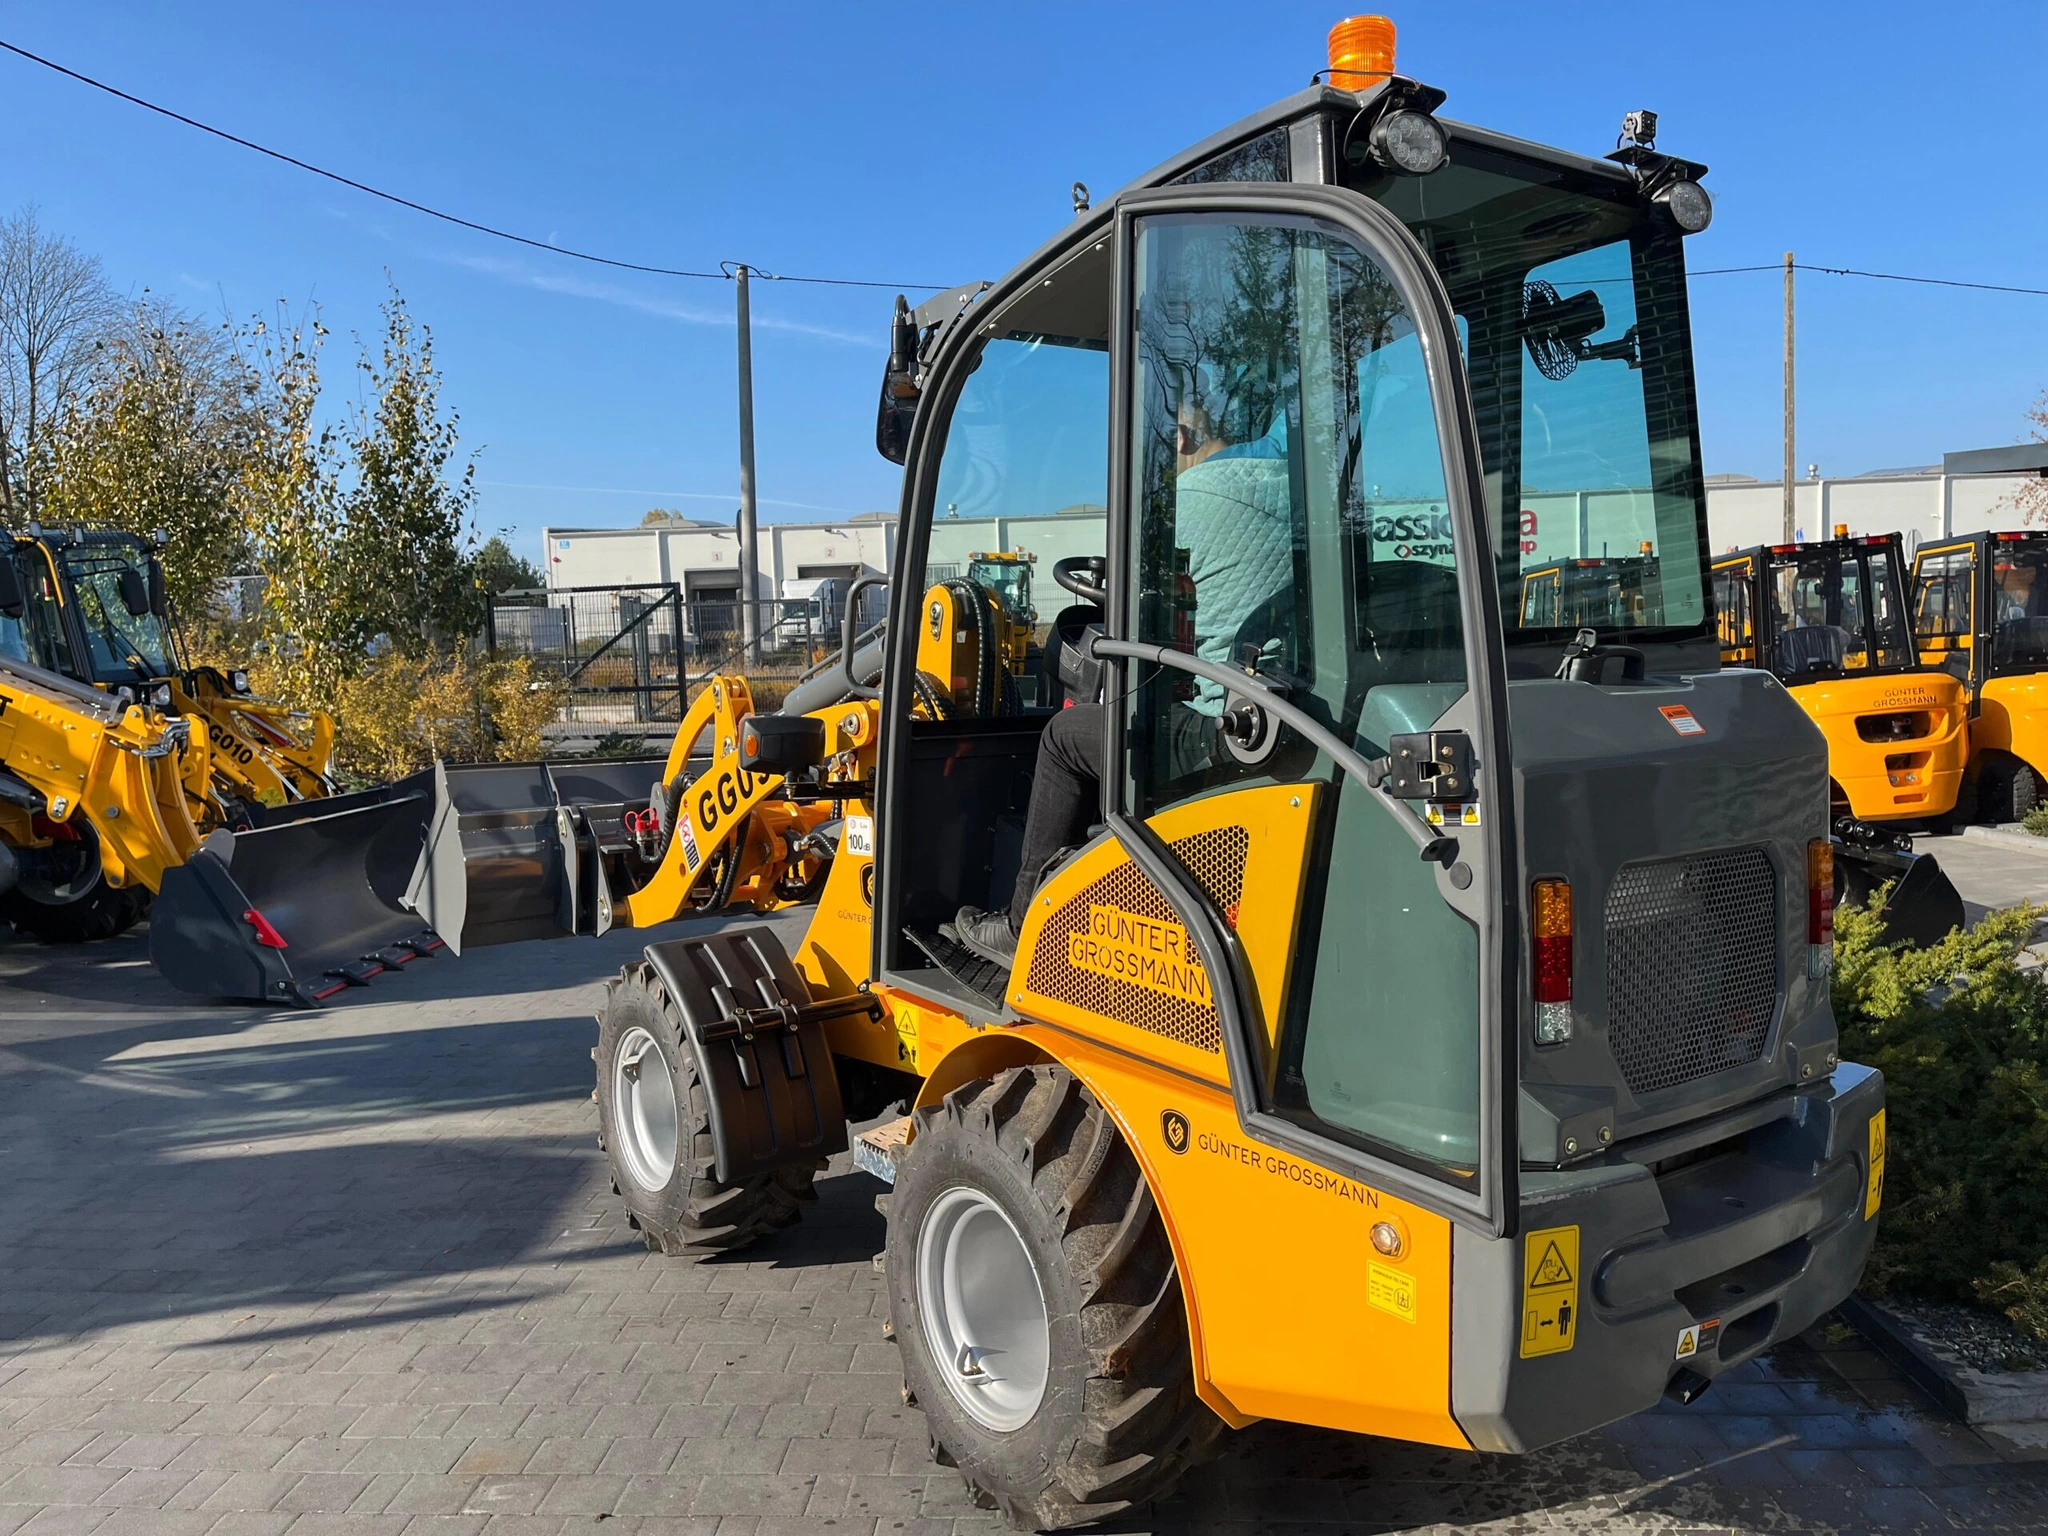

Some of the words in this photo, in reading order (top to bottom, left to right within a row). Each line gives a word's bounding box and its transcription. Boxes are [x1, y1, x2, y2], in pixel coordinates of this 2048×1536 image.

[1884, 686, 1925, 698] GÜNTER
[1873, 695, 1937, 708] GROSSMANN
[199, 714, 253, 764] G010
[848, 834, 863, 850] 100
[863, 843, 871, 851] dB
[838, 909, 867, 923] GÜNTER
[1093, 909, 1179, 957] GÜNTER
[1198, 1133, 1261, 1169] GÜNTER
[1265, 1156, 1379, 1209] GROSSMANN
